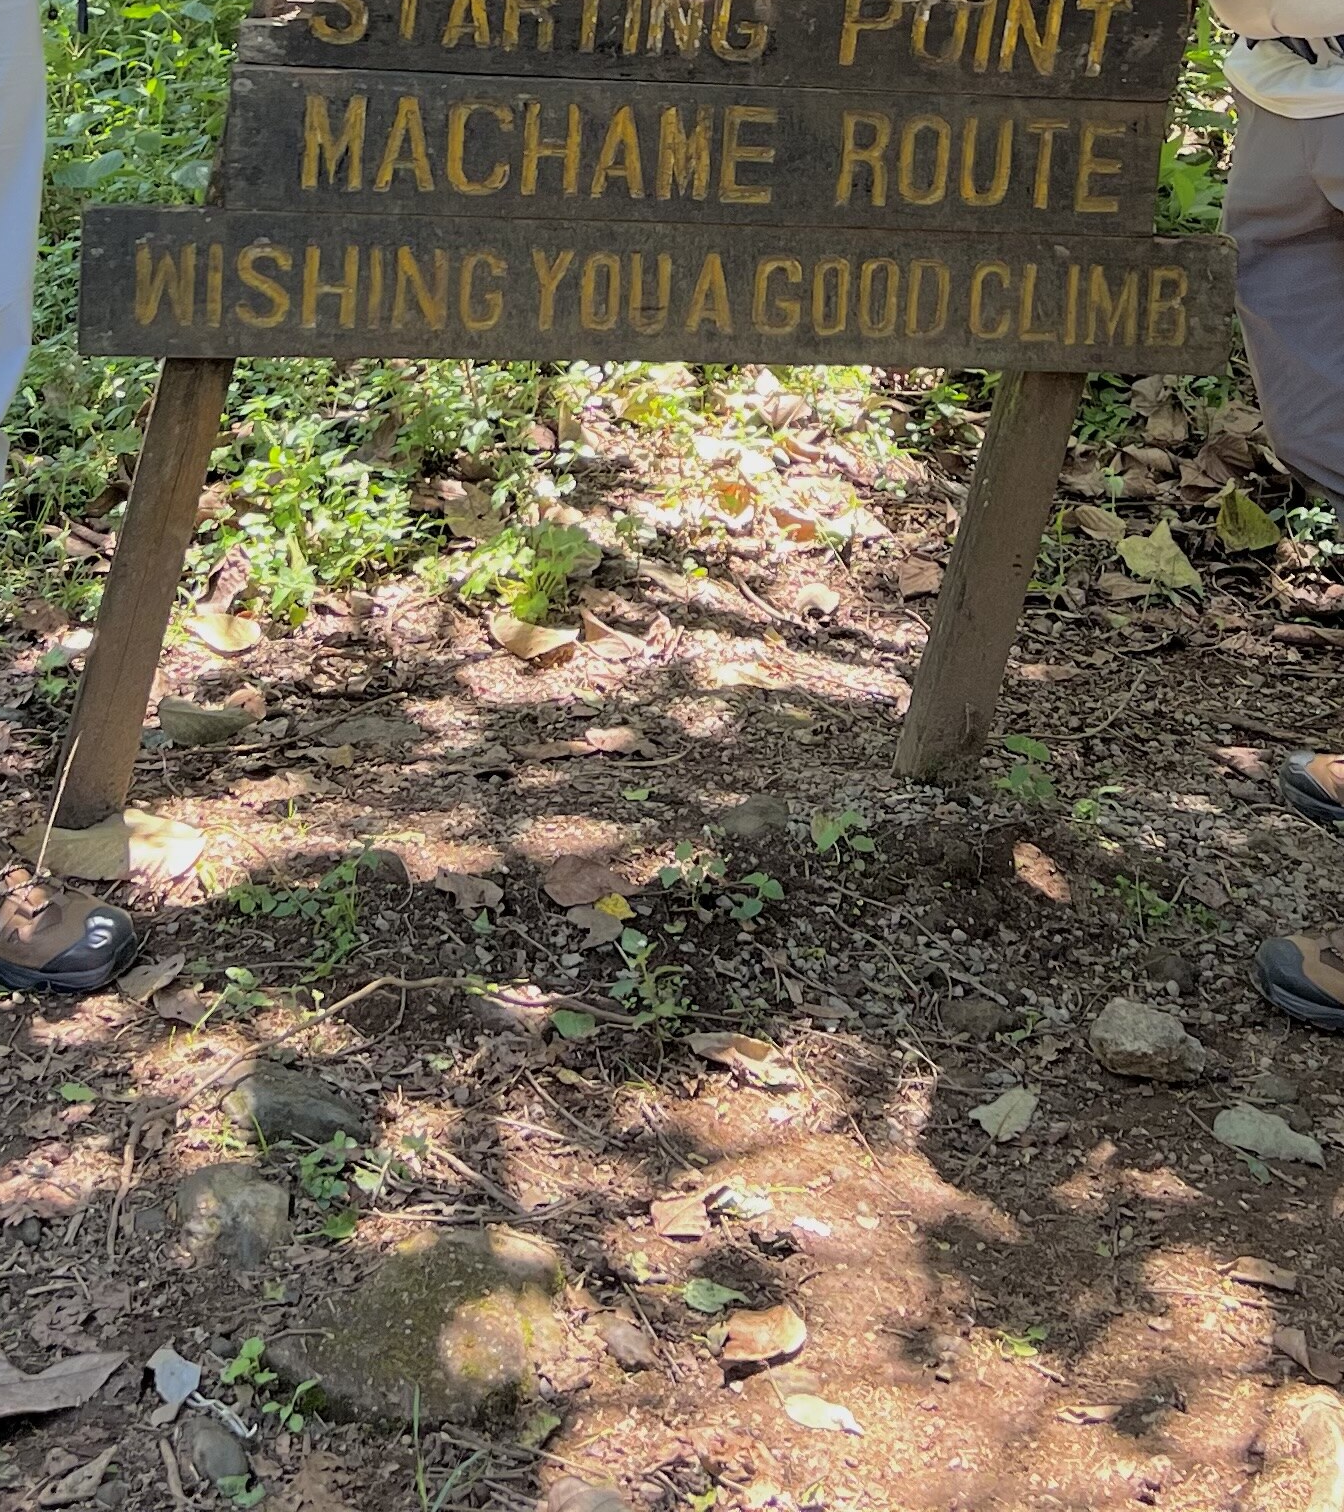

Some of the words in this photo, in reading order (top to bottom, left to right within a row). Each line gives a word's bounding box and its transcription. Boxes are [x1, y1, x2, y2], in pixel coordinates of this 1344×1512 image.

[301, 93, 779, 204] MACHAME
[834, 110, 1127, 213] ROUTE
[135, 238, 508, 331] WISHING
[532, 247, 673, 335] YOU
[684, 252, 733, 335] A
[752, 255, 951, 338] GOOD
[969, 260, 1189, 347] CLIMB
